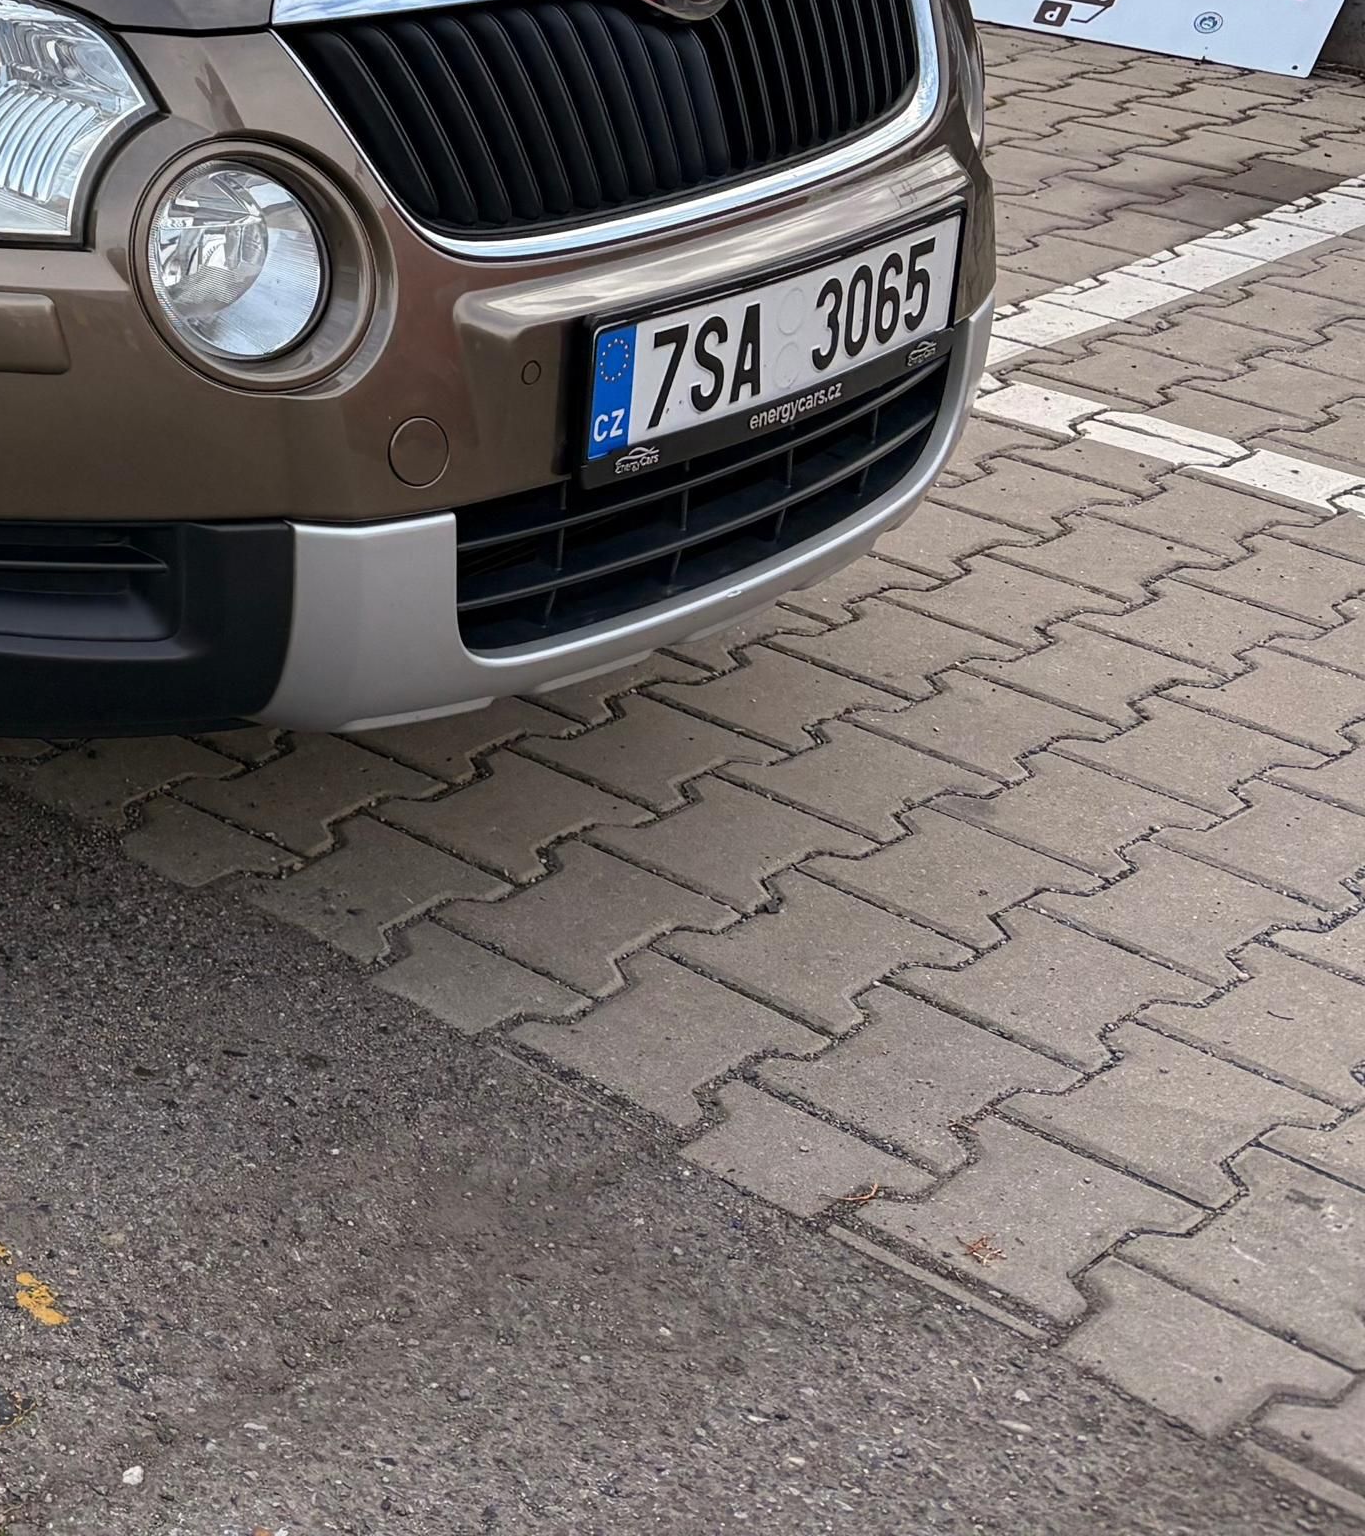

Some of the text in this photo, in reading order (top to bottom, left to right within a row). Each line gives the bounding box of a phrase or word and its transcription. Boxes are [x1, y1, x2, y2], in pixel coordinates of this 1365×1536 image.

[646, 237, 936, 431] 7SA 3065
[593, 408, 626, 442] CZ
[749, 382, 843, 431] energycars.cz
